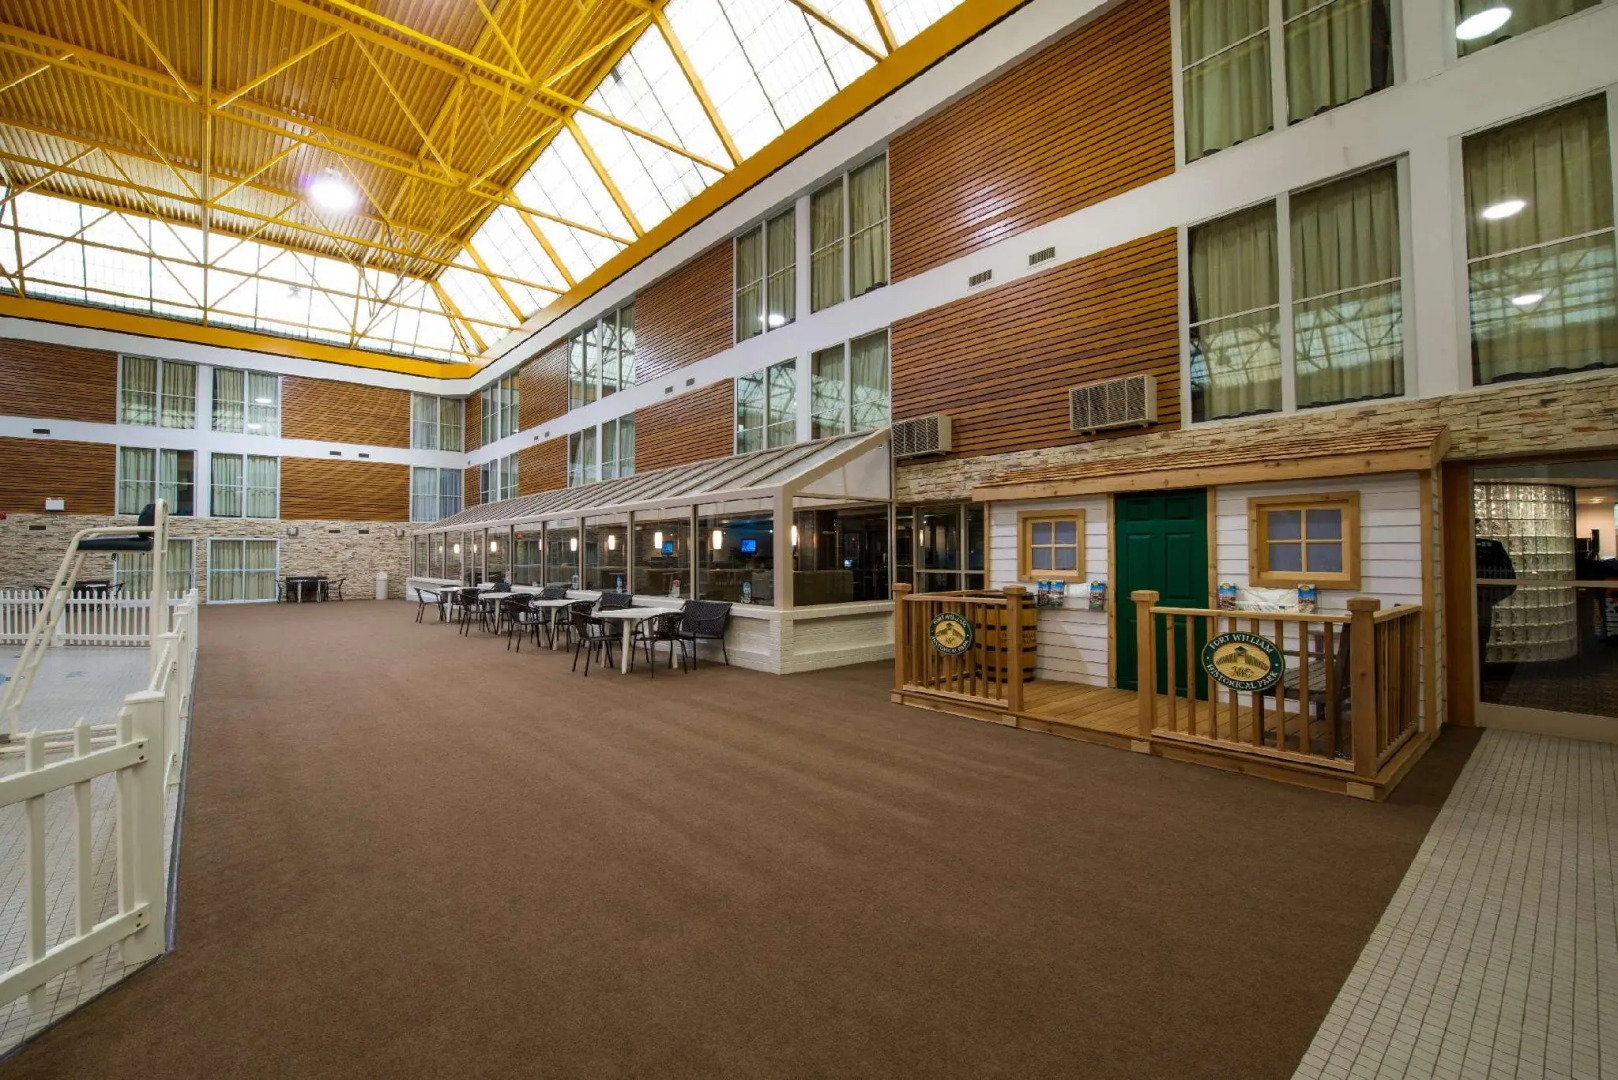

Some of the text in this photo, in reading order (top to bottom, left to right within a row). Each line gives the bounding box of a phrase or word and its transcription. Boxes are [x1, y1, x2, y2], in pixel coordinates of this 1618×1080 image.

[1209, 634, 1274, 653] FORT WILLIAM
[1206, 664, 1279, 689] HISTORICAL PARK
